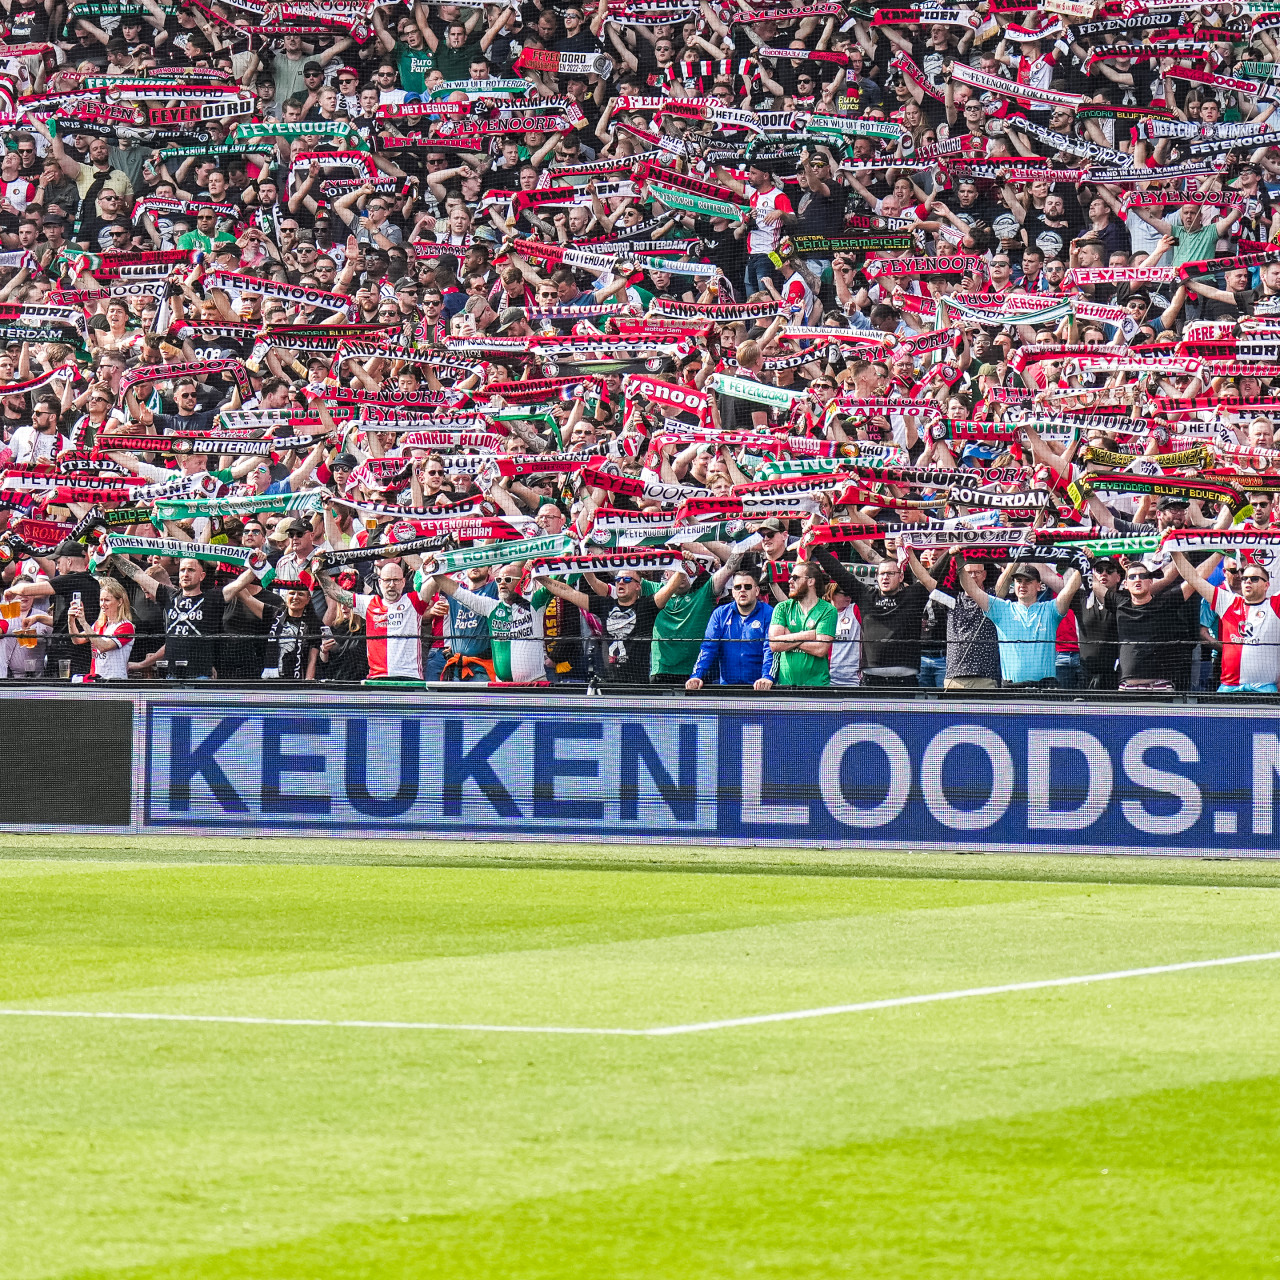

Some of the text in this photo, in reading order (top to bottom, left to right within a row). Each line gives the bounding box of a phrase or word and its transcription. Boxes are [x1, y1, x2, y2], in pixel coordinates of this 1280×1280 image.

[150, 102, 254, 120] FEYENOORD
[401, 102, 460, 114] HET LEGIOEN
[238, 122, 350, 136] FEYENOORD
[795, 238, 911, 249] LANDSKAMPIOEN
[881, 256, 985, 274] FEYENOORD
[220, 273, 348, 309] FEIJENOORD
[662, 300, 782, 317] LANDSKAMPIOEN
[420, 519, 483, 532] FEYENOORD
[108, 534, 250, 558] KOMEN WIJ UIT ROTTERDAM
[910, 530, 1026, 547] FEYENOORD
[463, 537, 556, 561] ROTTERDAM
[987, 548, 1006, 558] US
[535, 553, 675, 573] FEYENOORD
